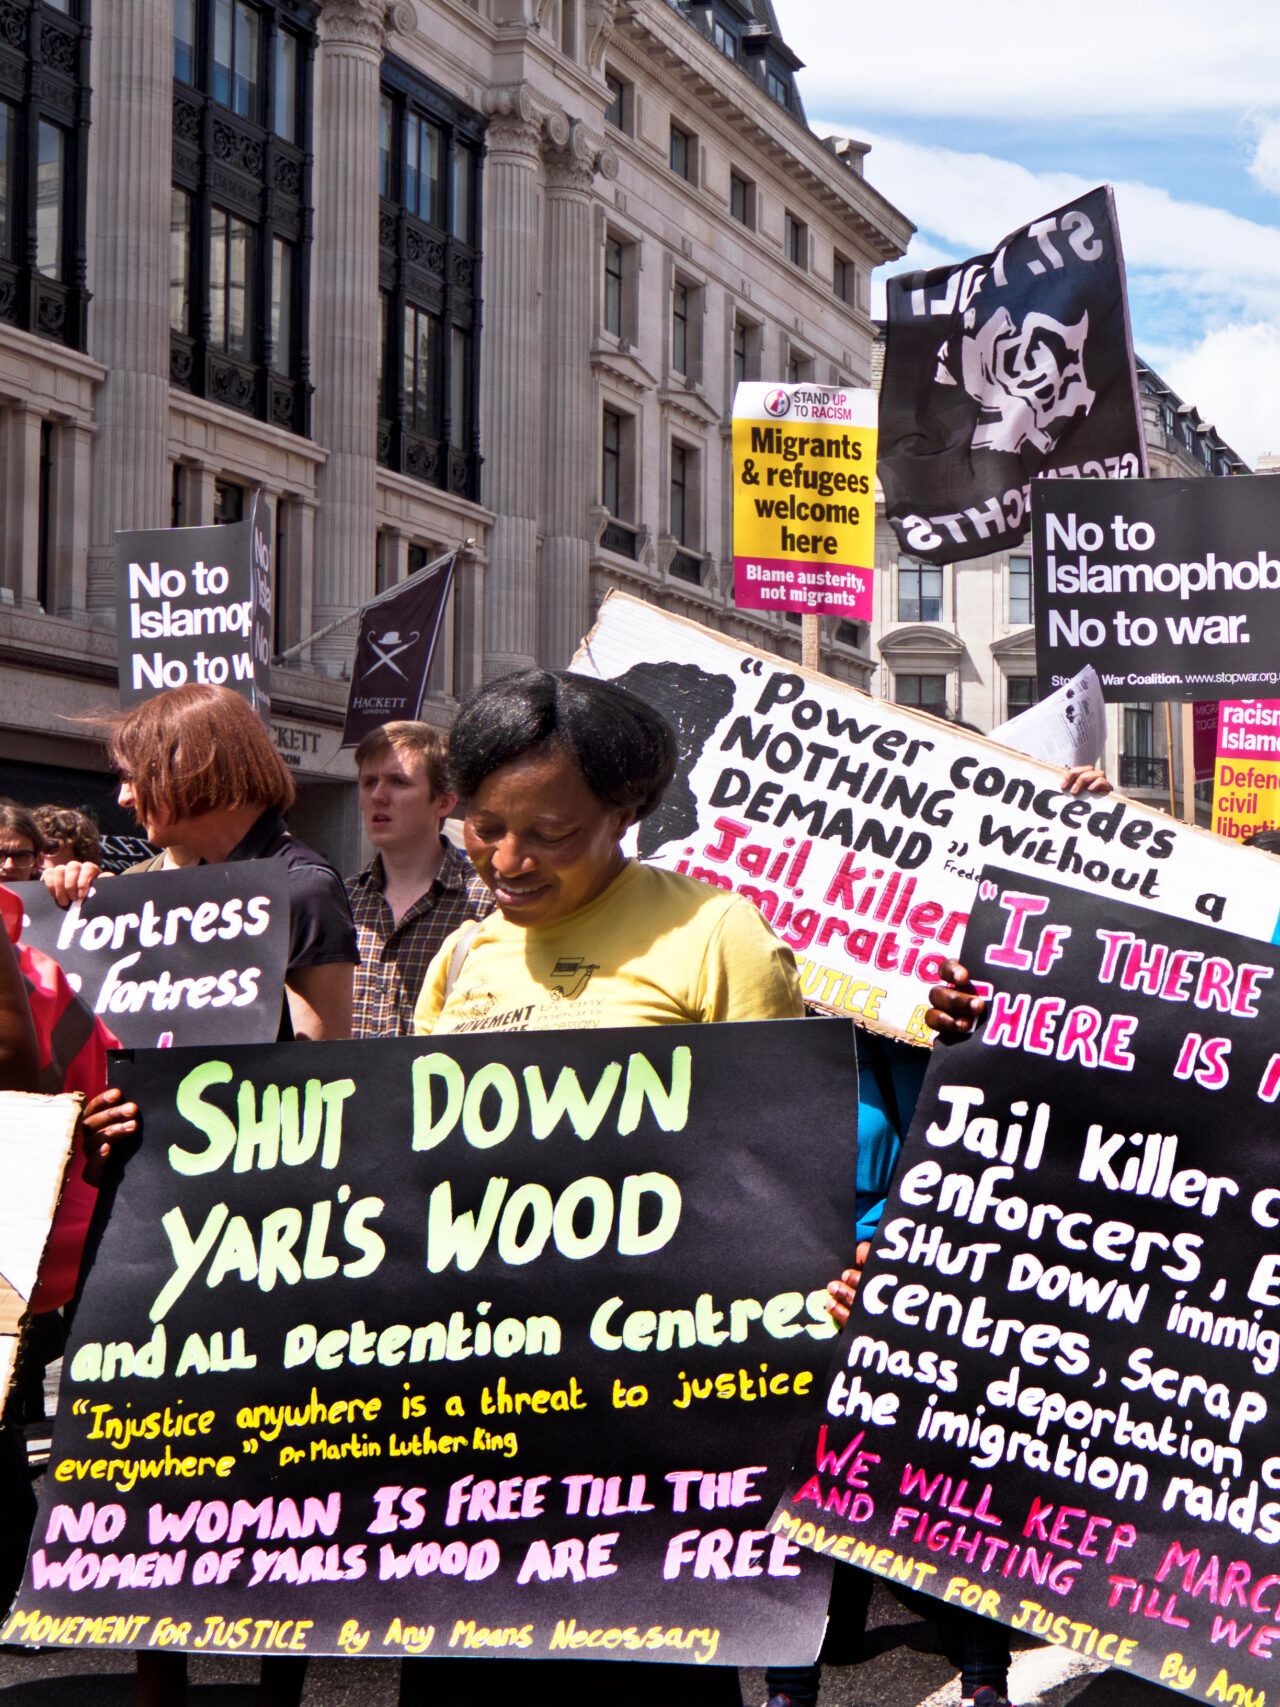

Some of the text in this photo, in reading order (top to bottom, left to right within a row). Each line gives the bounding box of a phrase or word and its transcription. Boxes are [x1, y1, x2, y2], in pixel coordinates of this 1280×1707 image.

[794, 392, 847, 406] STAND UP
[794, 405, 852, 420] TO RACISM
[751, 427, 862, 461] Migrants
[742, 458, 870, 496] & refugees
[754, 495, 860, 525] welcome
[781, 526, 838, 554] here
[1046, 513, 1156, 551] No to
[128, 562, 229, 599] No to
[746, 564, 865, 592] Blame austerity,
[760, 586, 856, 606] not migrants
[1048, 610, 1250, 648] No to war.
[132, 652, 228, 690] No to
[1102, 674, 1124, 686] War
[1127, 673, 1183, 685] Coalition.
[353, 697, 407, 710] HACKETT
[721, 716, 956, 827] NOTHING
[1195, 893, 1228, 922] a
[950, 757, 1177, 860] concedes
[1218, 792, 1258, 814] civil
[1096, 929, 1274, 1018] THERE
[1173, 1033, 1231, 1090] IS
[168, 1045, 692, 1176] SHUT DOWN
[926, 1085, 1050, 1170] Jail
[148, 1172, 682, 1324] YARL'S WOOD
[236, 1386, 382, 1442] anywhere
[401, 1382, 427, 1420] is
[444, 1395, 466, 1416] a
[481, 1376, 587, 1416] threat
[612, 1379, 648, 1408] to
[673, 1363, 813, 1408] justice
[280, 1446, 306, 1466] Dr
[310, 1434, 381, 1462] Martin
[390, 1427, 468, 1457] Luther
[472, 1428, 518, 1458] King
[816, 1424, 882, 1489] WE
[900, 1463, 1002, 1526] WILL
[1022, 1496, 1136, 1564] KEEP
[772, 1509, 1138, 1667] MOVEMENT FOR JUSTICE
